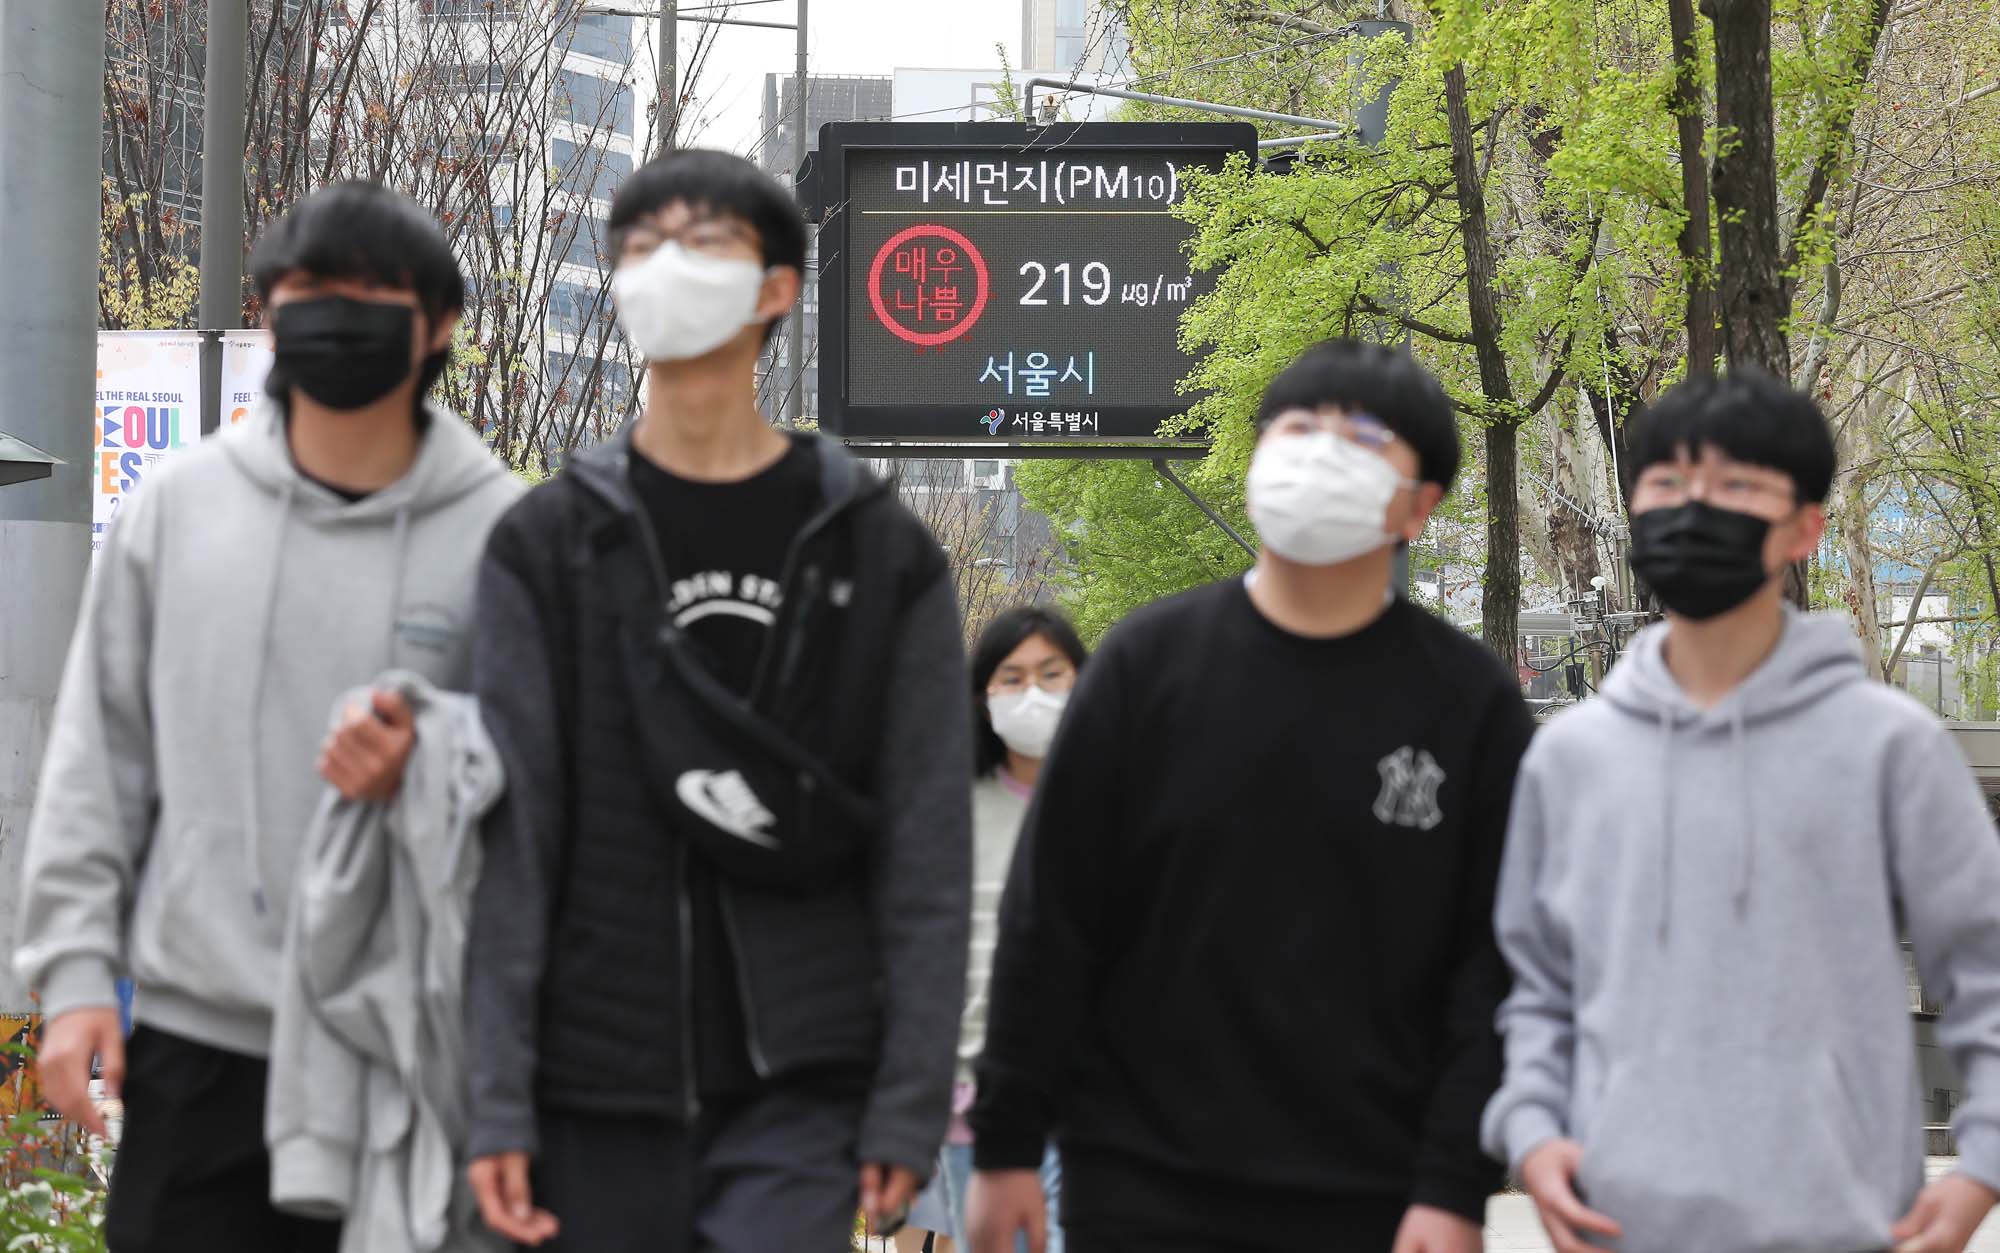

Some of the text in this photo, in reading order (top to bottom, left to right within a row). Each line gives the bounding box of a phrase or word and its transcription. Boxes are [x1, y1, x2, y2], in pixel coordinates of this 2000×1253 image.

[896, 160, 1177, 205] 미세먼지(PM10)
[896, 247, 963, 283] 매우
[1019, 261, 1111, 306] 219
[896, 285, 963, 321] 나쁨
[979, 351, 1093, 396] 서울시
[106, 391, 124, 401] THE
[126, 391, 150, 402] REAL
[152, 392, 184, 403] SEOUL
[233, 392, 252, 403] FEEL
[1012, 412, 1099, 432] 서울특별시
